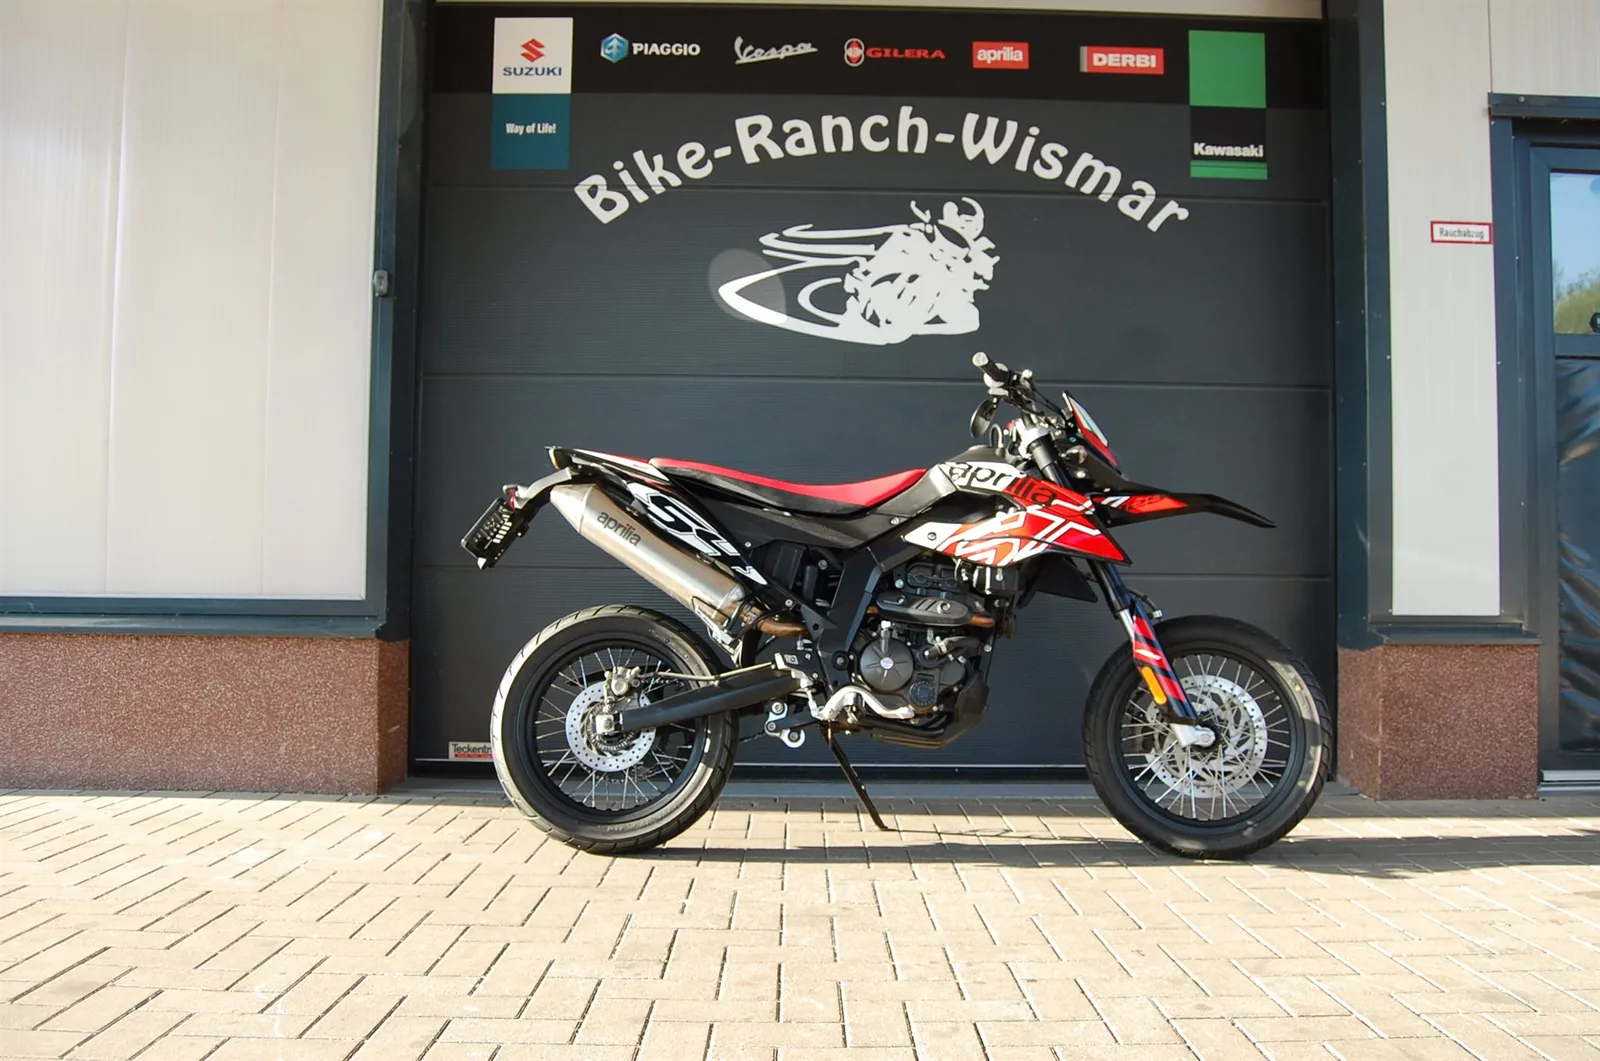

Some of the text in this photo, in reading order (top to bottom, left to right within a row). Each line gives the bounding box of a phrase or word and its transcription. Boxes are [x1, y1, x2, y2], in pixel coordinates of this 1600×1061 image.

[632, 43, 701, 56] PIAGGIO
[734, 36, 818, 64] Vespa
[866, 47, 946, 59] GILERA
[976, 46, 1023, 64] aprilia
[1092, 52, 1157, 68] DERBI
[503, 66, 563, 77] SUZUKI
[505, 122, 557, 136] Way of Life!
[1193, 142, 1264, 158] Kawasaki
[1439, 227, 1484, 240] Rauchabzug
[949, 461, 1058, 508] aprilia
[597, 511, 642, 547] aprilia
